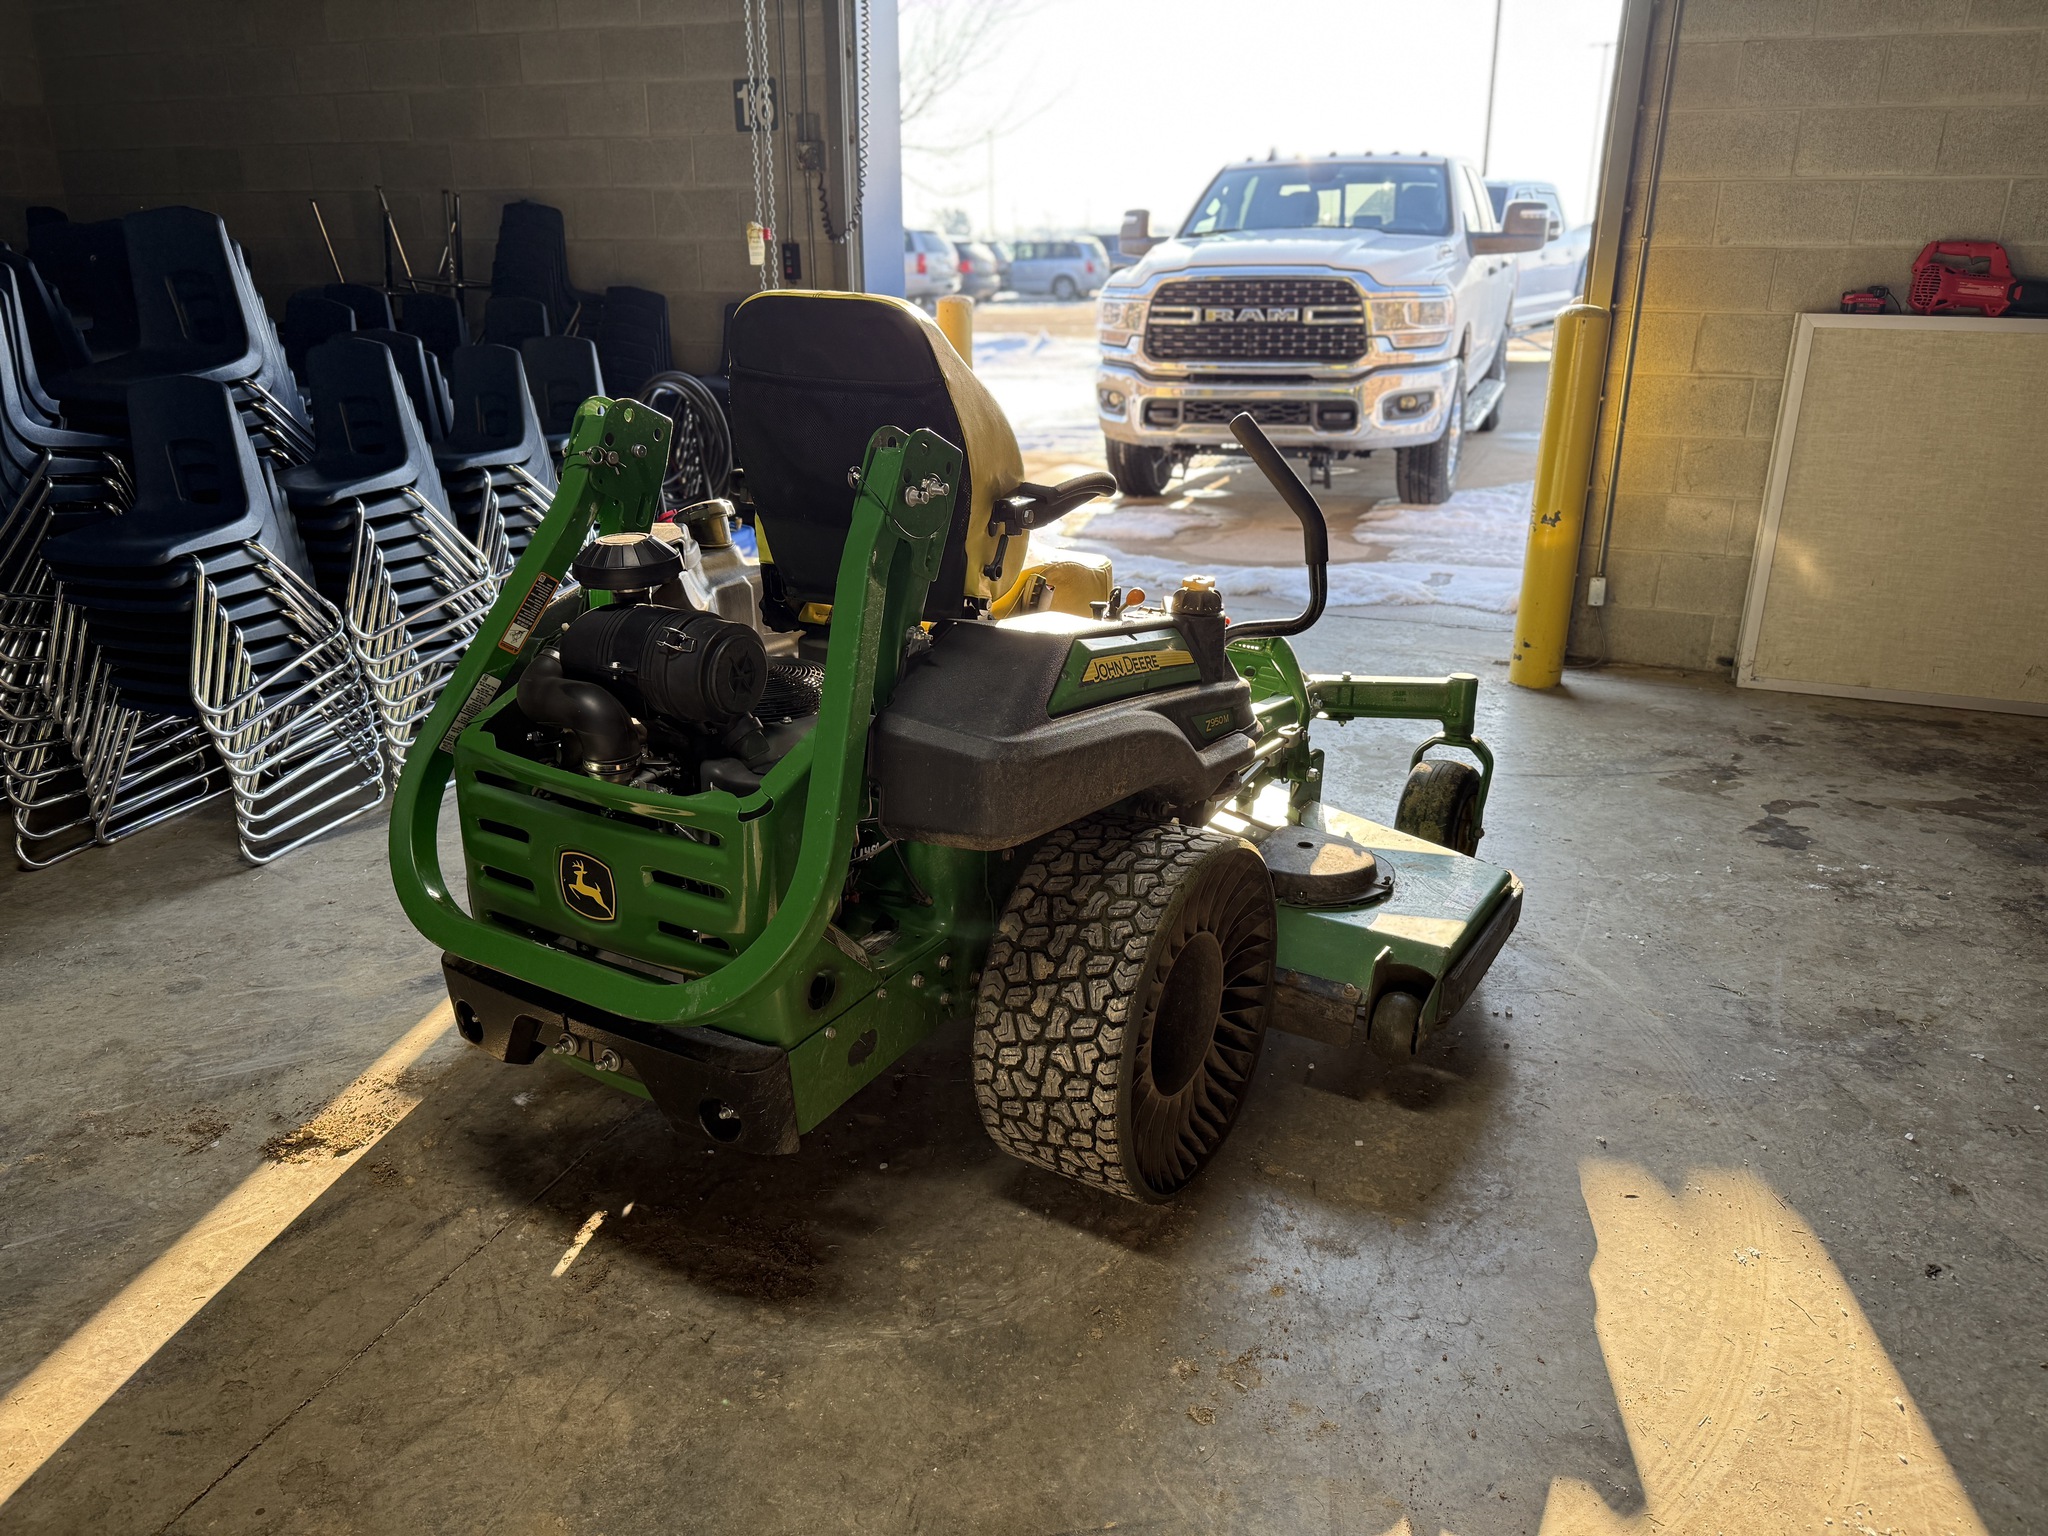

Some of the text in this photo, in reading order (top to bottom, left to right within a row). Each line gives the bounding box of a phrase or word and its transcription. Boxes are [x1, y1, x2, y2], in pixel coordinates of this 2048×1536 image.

[737, 83, 774, 127] 16
[1205, 308, 1298, 322] RAM
[1094, 655, 1159, 681] JOHN DEERE
